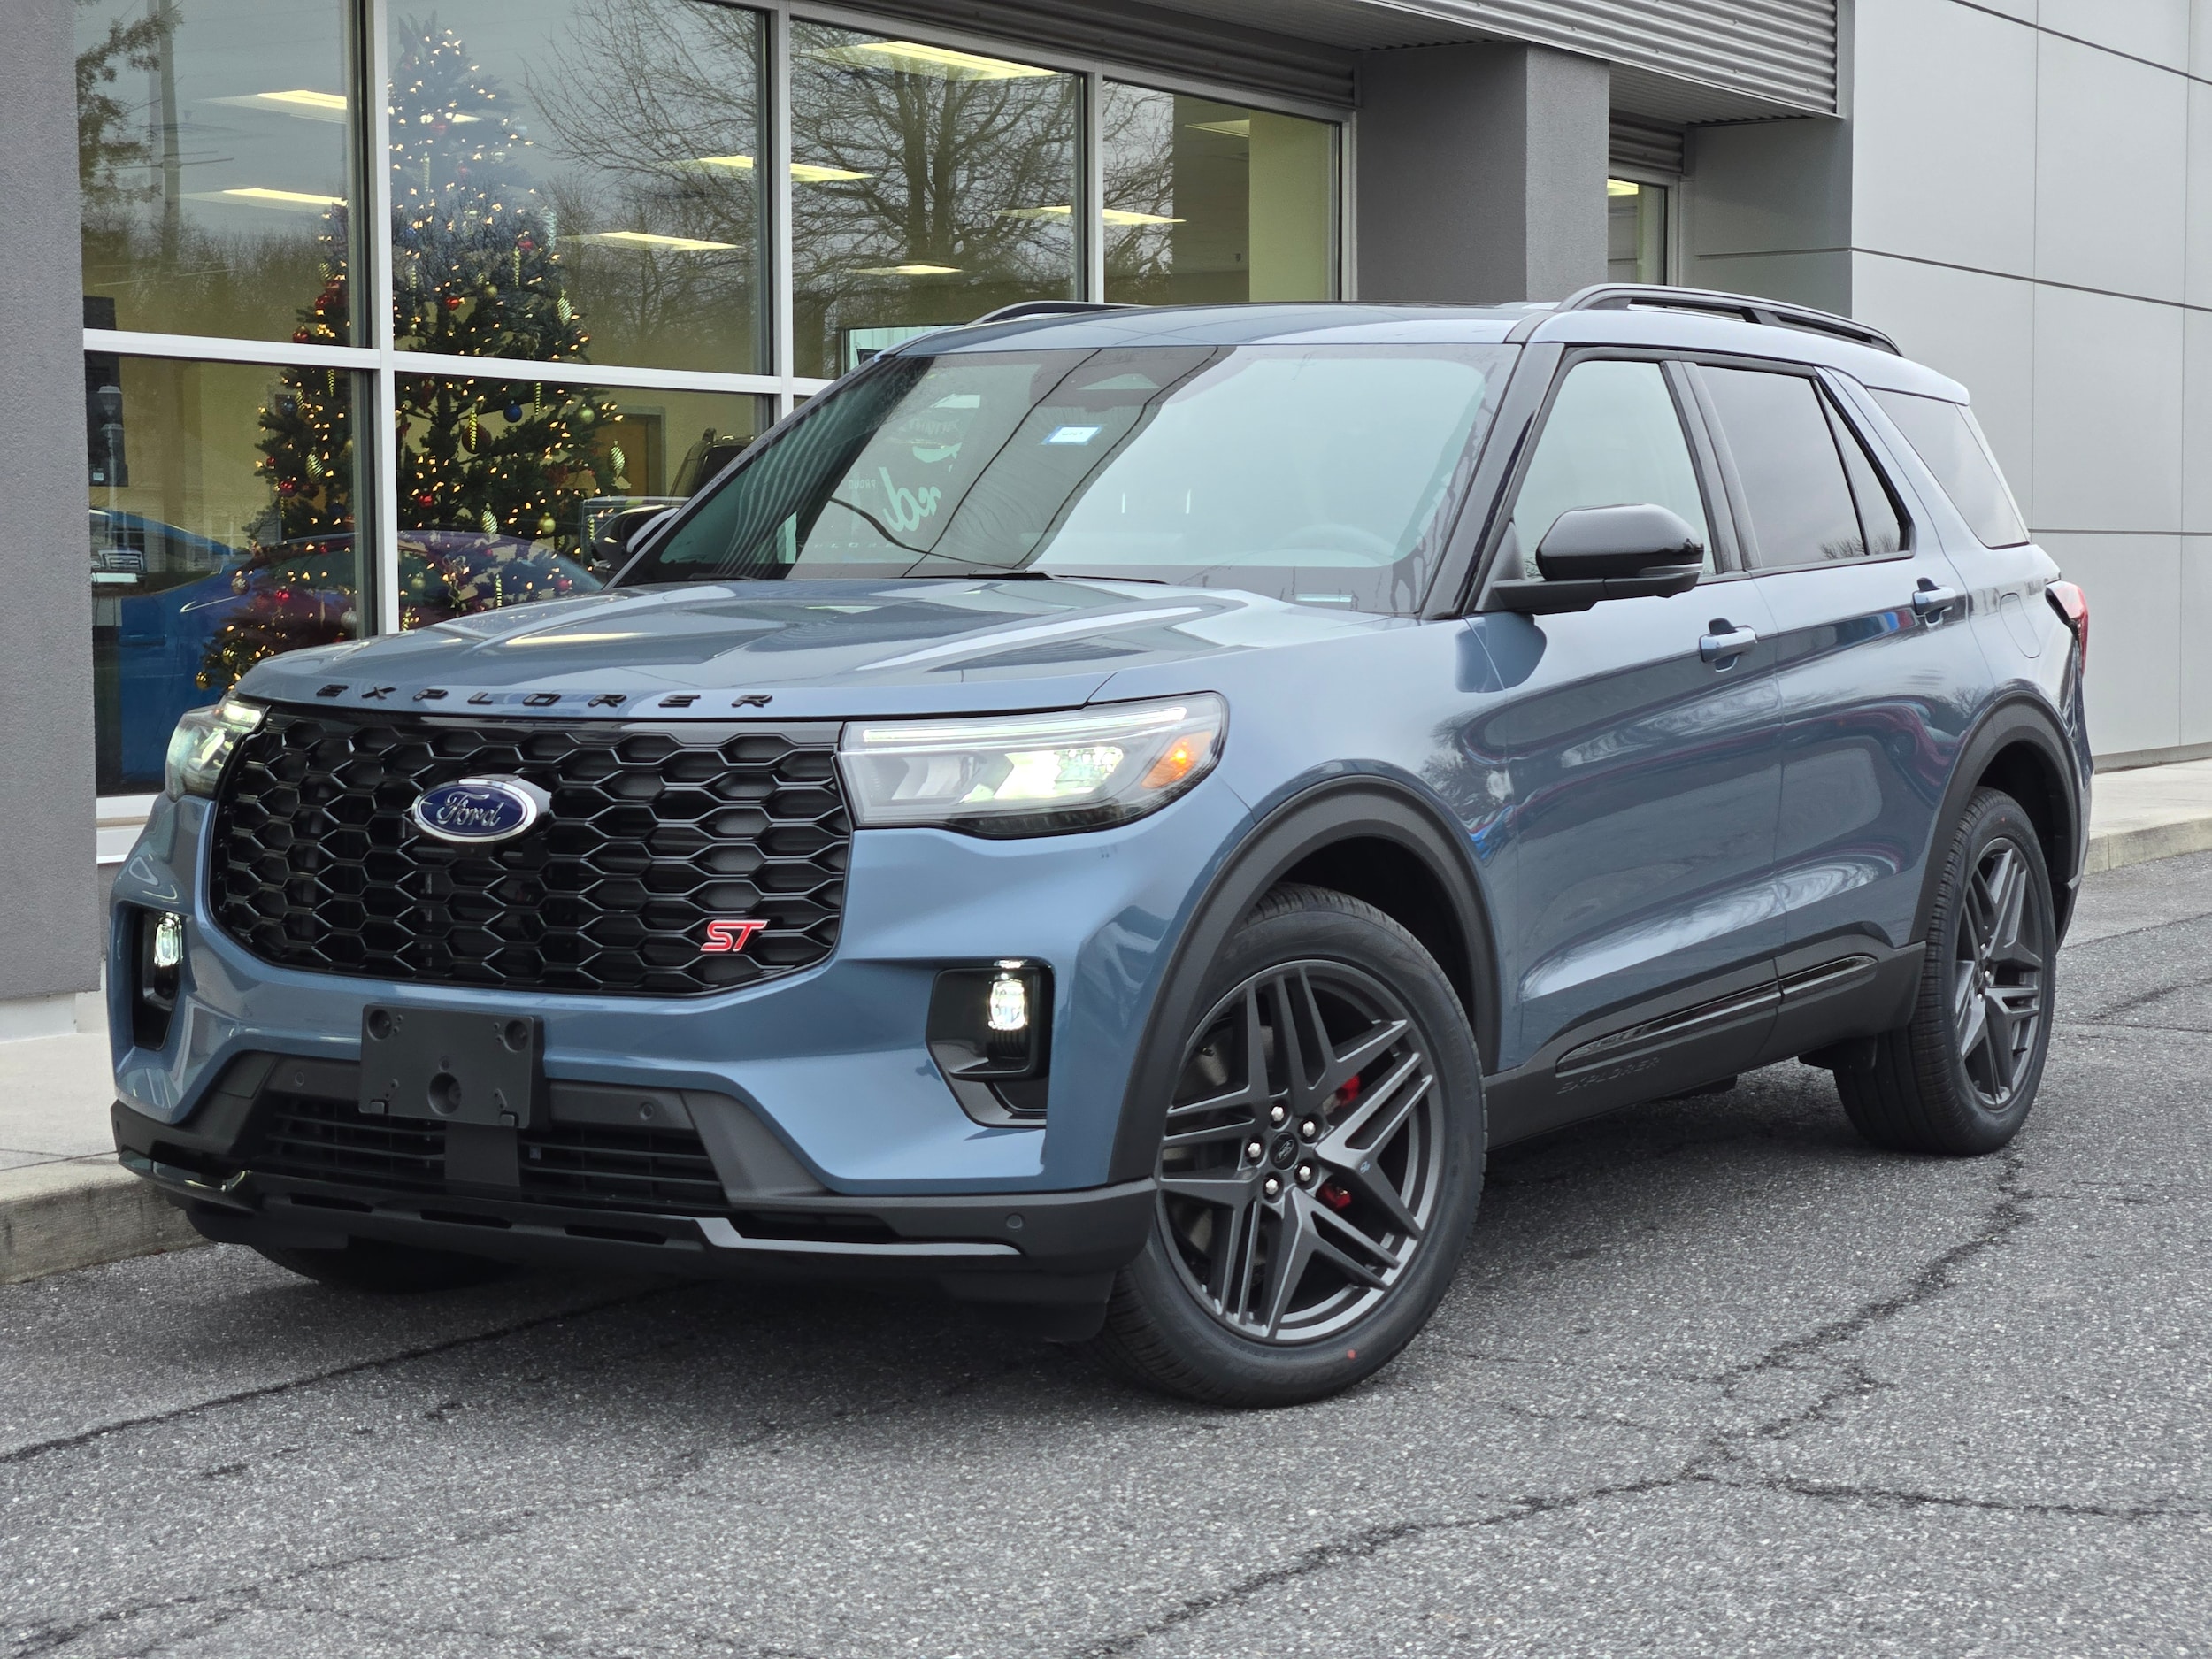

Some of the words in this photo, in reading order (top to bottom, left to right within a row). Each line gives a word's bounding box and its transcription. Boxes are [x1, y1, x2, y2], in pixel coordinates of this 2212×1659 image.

[316, 684, 773, 708] EXPLORER
[436, 791, 505, 826] Ford
[700, 919, 770, 952] ST
